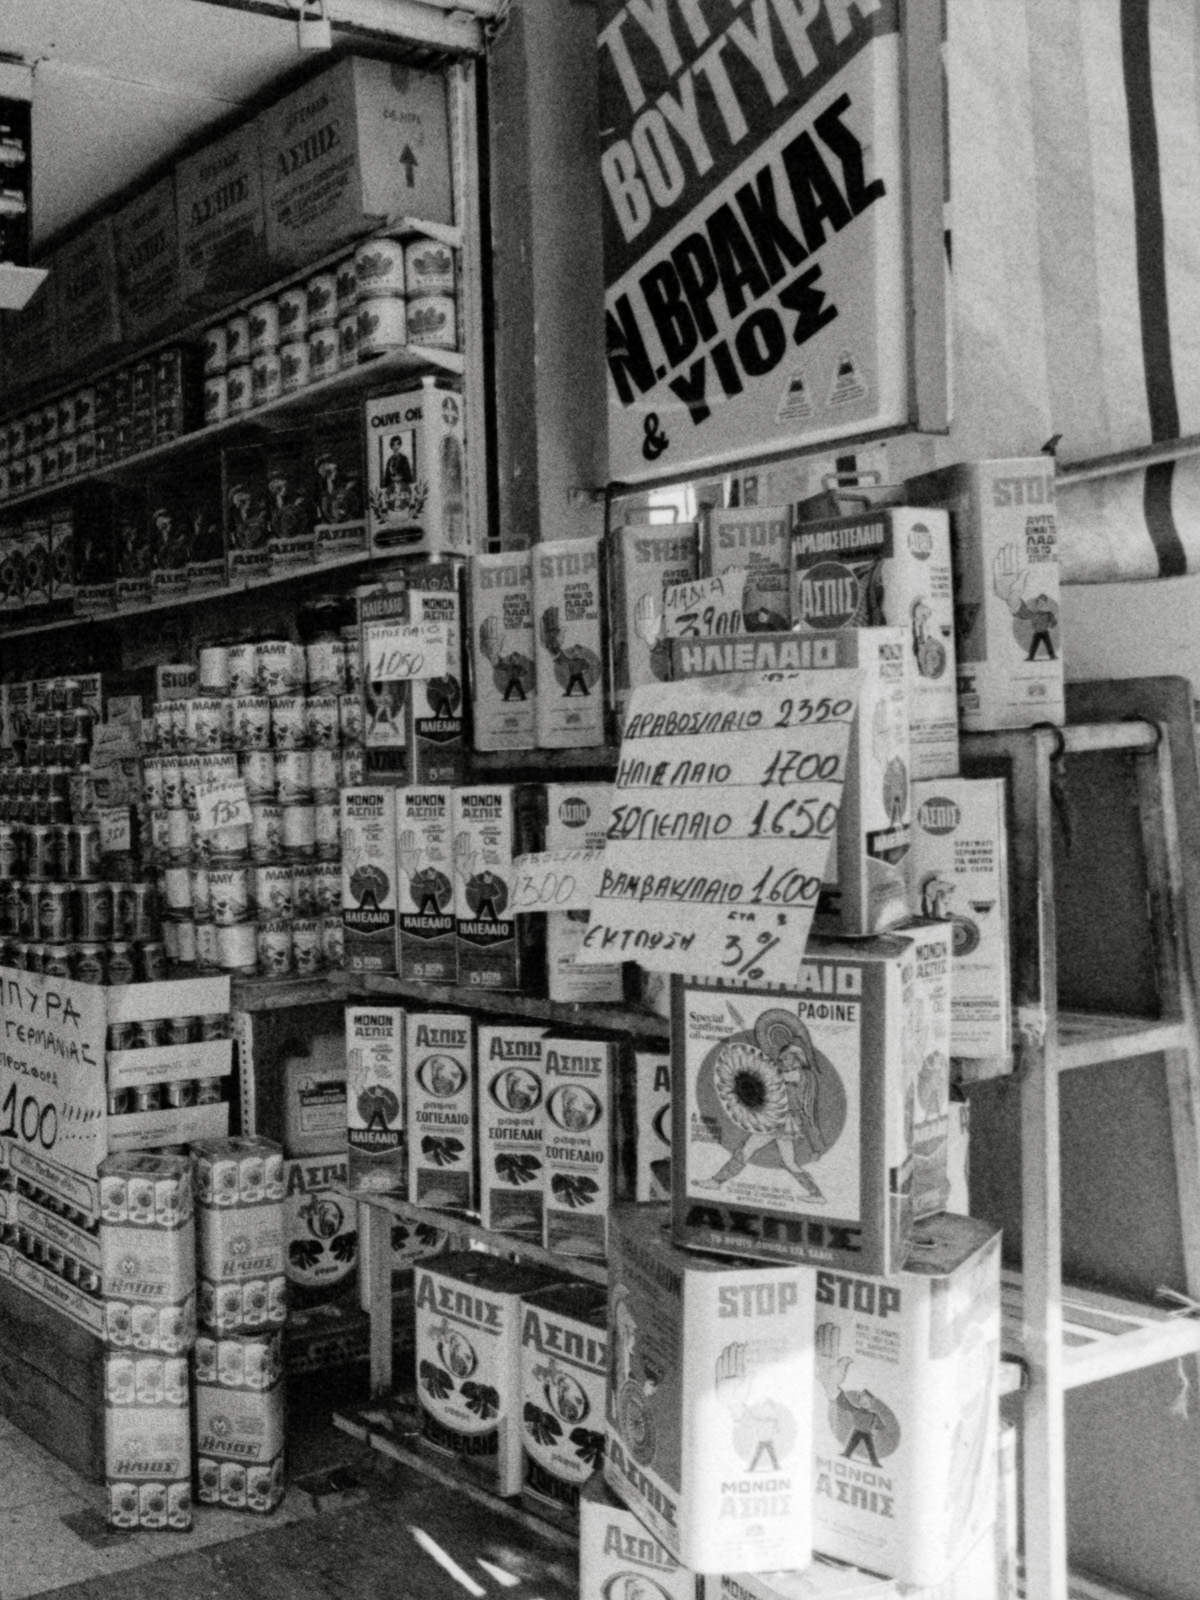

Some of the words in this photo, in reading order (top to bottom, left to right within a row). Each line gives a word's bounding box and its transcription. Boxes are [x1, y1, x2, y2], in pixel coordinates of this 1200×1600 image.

[642, 412, 669, 460] &
[669, 263, 839, 425] ΥΙΟΣ
[371, 410, 401, 428] OLIVE
[404, 405, 424, 422] OIL
[719, 520, 786, 548] STOP
[1027, 535, 1057, 545] ΛΑΔ
[801, 577, 854, 619] ΑΣΠΙΣ
[680, 639, 838, 673] ΗΛΙΕΛΑΙΟ
[774, 698, 853, 729] 2350
[761, 750, 840, 788] 1700
[721, 931, 781, 981] 3%
[353, 1013, 394, 1027] ΜΟΝΟΝ
[797, 1001, 857, 1023] ΡΑΦΙΝΕ
[415, 1024, 468, 1049] ΑΣΠΙΣ
[488, 1036, 543, 1062] ΑΣΠΙΣ
[545, 1050, 602, 1077] ΑΣΠΙΣ
[415, 1110, 469, 1126] ΣΟΓΙΕΛΑΙΟ
[488, 1127, 543, 1143] ΣΟΓΙΕΛΑΙ
[545, 1146, 605, 1164] ΣΟΓΙΕΛΑΙΟ
[685, 1204, 863, 1252] ΑΣΠΙΣ
[416, 1273, 504, 1328] ΑΣΠΙΣ
[717, 1281, 798, 1318] STOP
[815, 1269, 901, 1319] STOP
[721, 1478, 792, 1494] ΜΟΝΟΝ
[816, 1456, 893, 1492] ΜΟΝΟΝ
[719, 1495, 793, 1521] ΑΣΠΙΣ
[815, 1473, 895, 1520] ΑΣΠΙΣ
